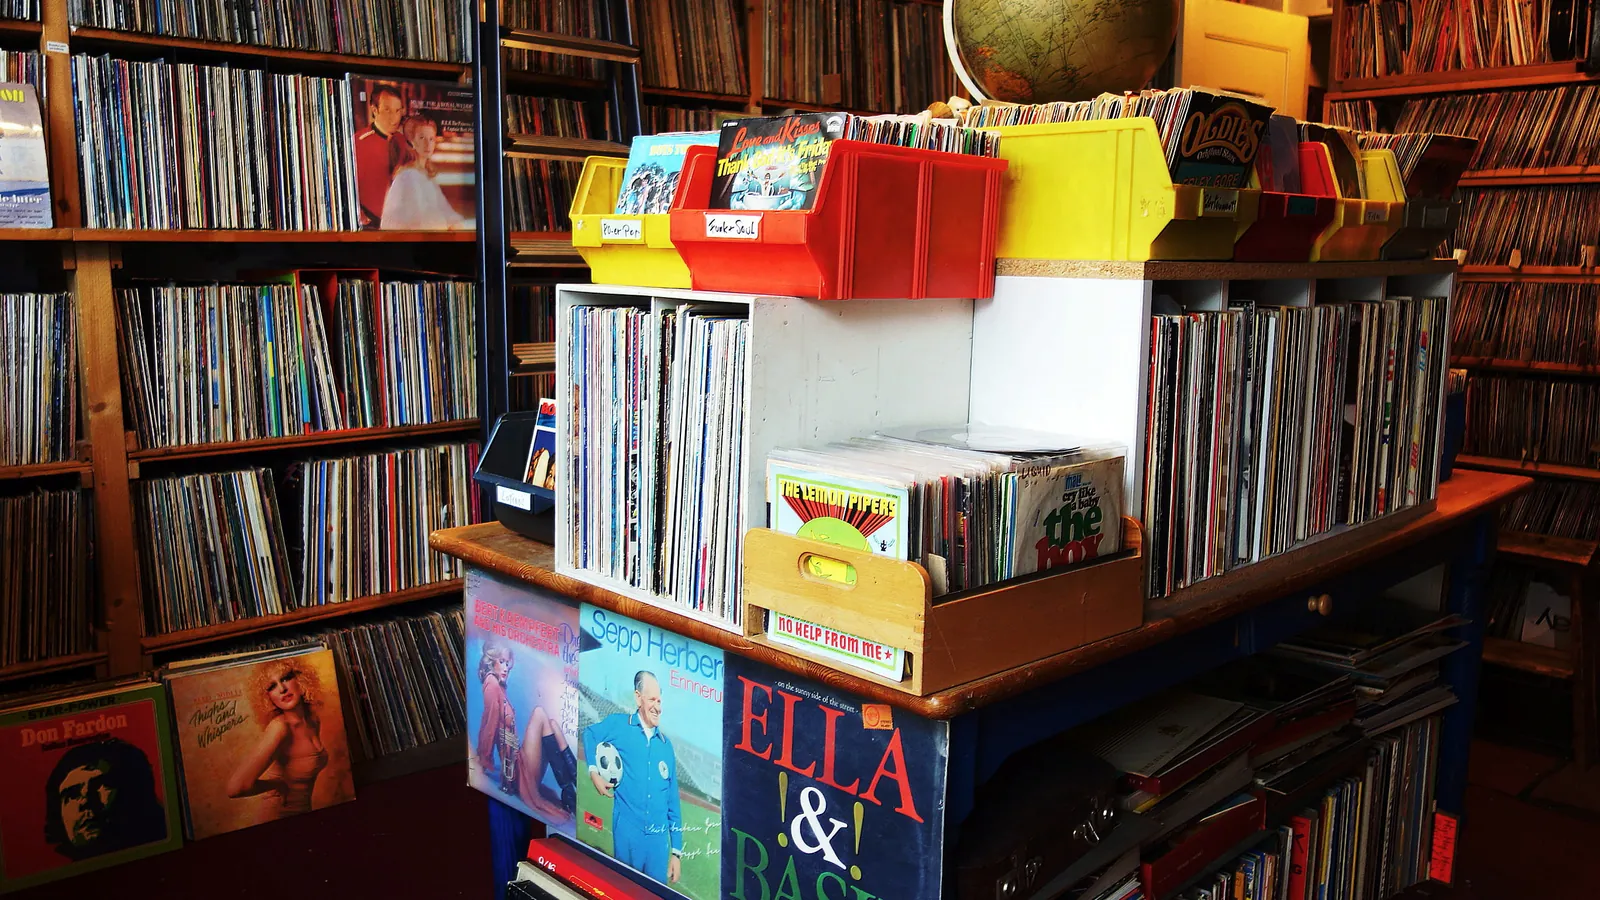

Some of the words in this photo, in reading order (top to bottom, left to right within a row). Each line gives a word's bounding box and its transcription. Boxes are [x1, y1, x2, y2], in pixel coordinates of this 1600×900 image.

[717, 156, 749, 177] Thank
[797, 137, 833, 158] Frida
[726, 126, 763, 159] Love
[762, 126, 783, 145] and
[780, 116, 821, 145] Kisses
[1181, 111, 1265, 163] OLDIES
[541, 402, 556, 416] BO
[780, 479, 801, 499] THE
[802, 483, 846, 508] LEMON
[849, 493, 897, 518] PIPERS
[1062, 489, 1078, 504] cry
[1079, 486, 1096, 499] like
[1078, 496, 1100, 511] baby
[1043, 501, 1103, 549] the
[473, 616, 491, 633] AND
[491, 622, 507, 638] HIS
[507, 627, 560, 657] ORCHESTRA
[474, 599, 499, 621] BERT
[499, 608, 561, 643] KAEMPFERT
[778, 616, 793, 633] NO
[795, 621, 822, 642] HELP
[825, 630, 859, 654] FROM
[862, 640, 882, 661] ME
[591, 609, 642, 657] Sepp
[647, 628, 724, 681] Herber
[189, 701, 230, 728] Thighs
[215, 700, 237, 725] and
[777, 681, 786, 689] on
[785, 682, 795, 693] the
[795, 687, 811, 699] sunny
[811, 691, 822, 702] side
[822, 694, 829, 704] of
[829, 696, 839, 708] the
[839, 702, 856, 714] street
[20, 727, 59, 748] Don
[62, 714, 129, 740] Fardon
[197, 714, 250, 749] Whispers
[734, 675, 925, 824] ELLA
[790, 786, 848, 870] &
